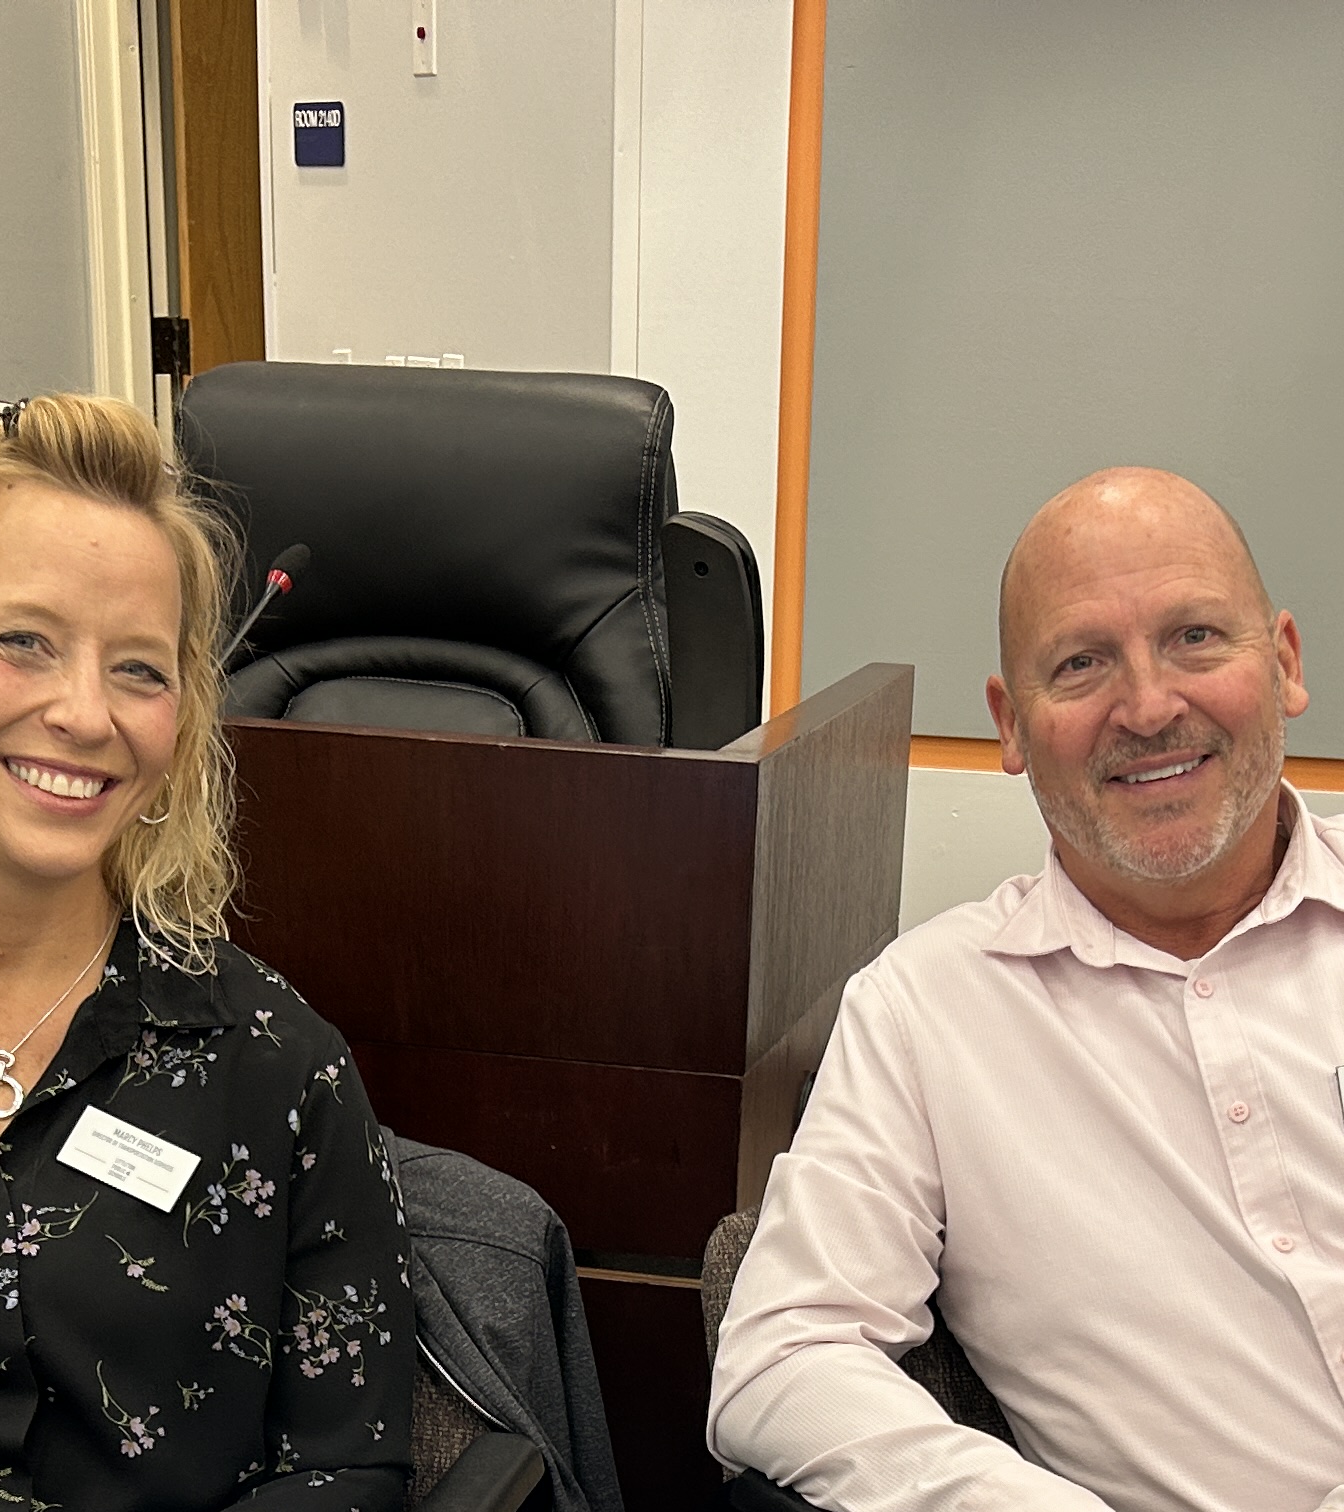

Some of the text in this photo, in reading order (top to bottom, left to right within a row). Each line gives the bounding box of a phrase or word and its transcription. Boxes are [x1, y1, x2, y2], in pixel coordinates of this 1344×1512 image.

[295, 110, 317, 127] ROOM
[113, 1129, 163, 1156] MARCY PHELPS
